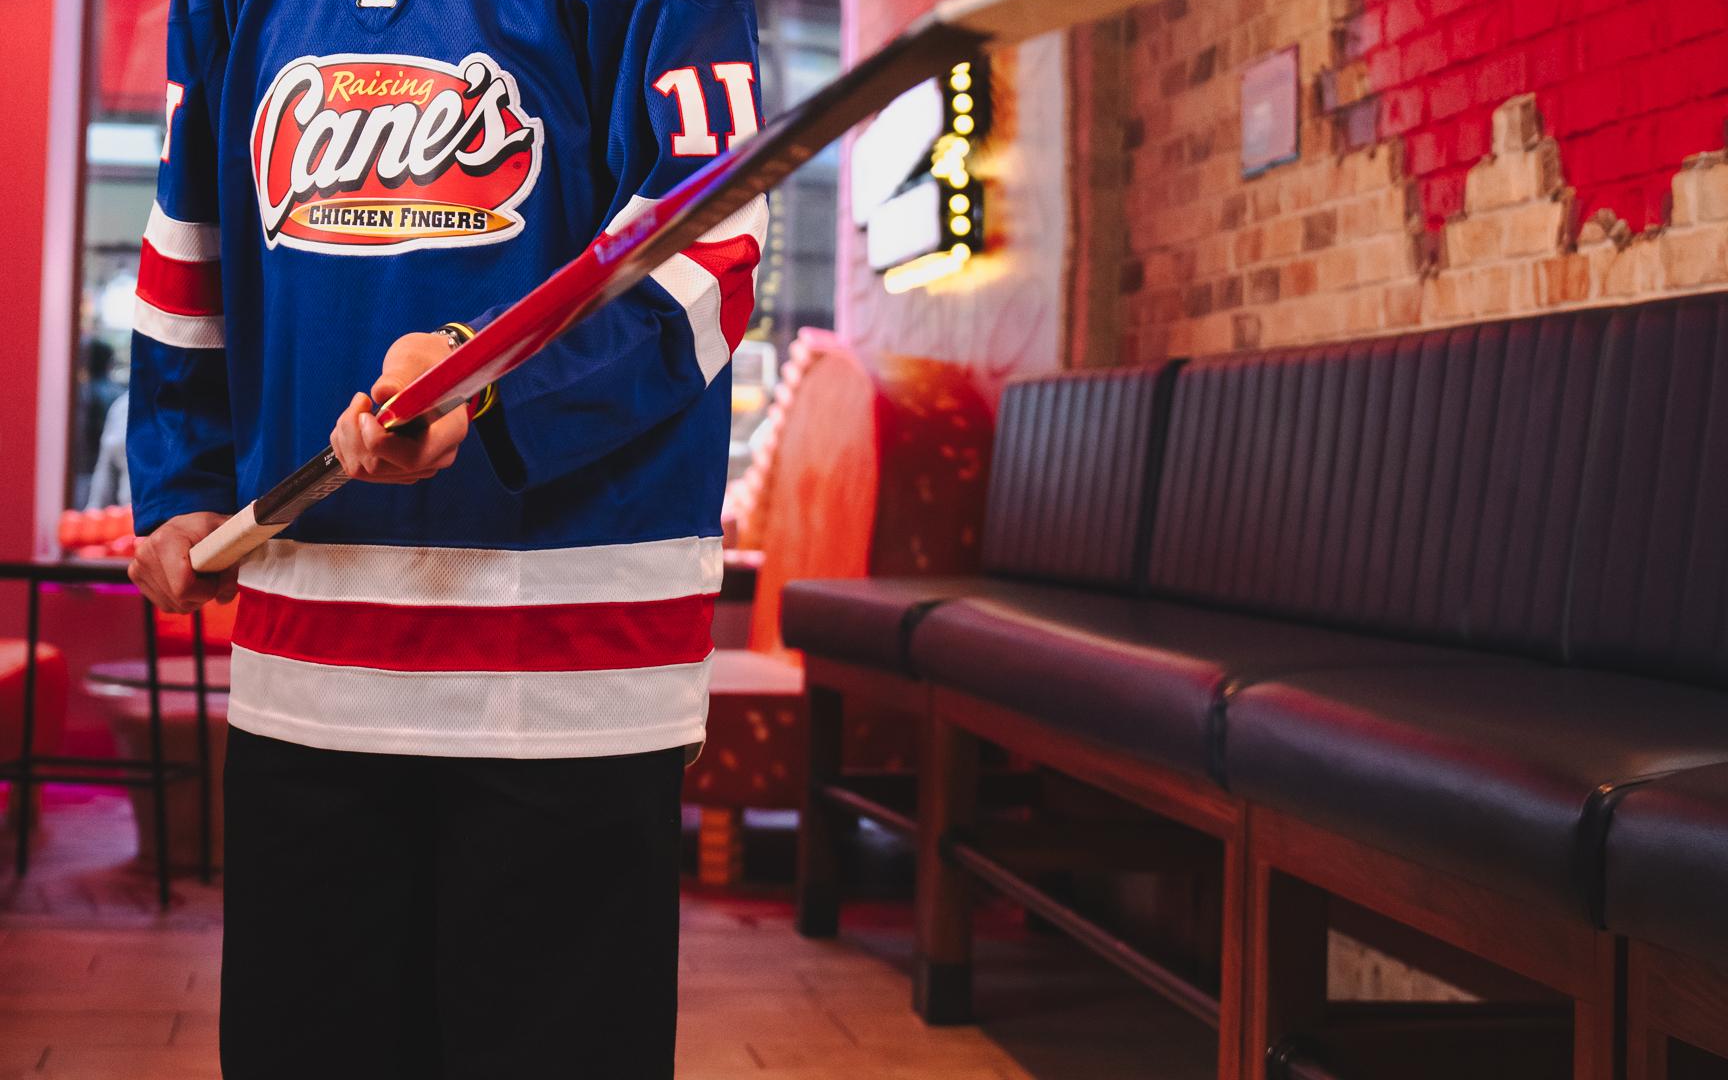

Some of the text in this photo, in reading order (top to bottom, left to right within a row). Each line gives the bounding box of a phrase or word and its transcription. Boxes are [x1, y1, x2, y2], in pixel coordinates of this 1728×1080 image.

[327, 70, 435, 105] Raising
[260, 62, 534, 240] Cane's
[308, 206, 487, 231] CHICKEN FINGERS
